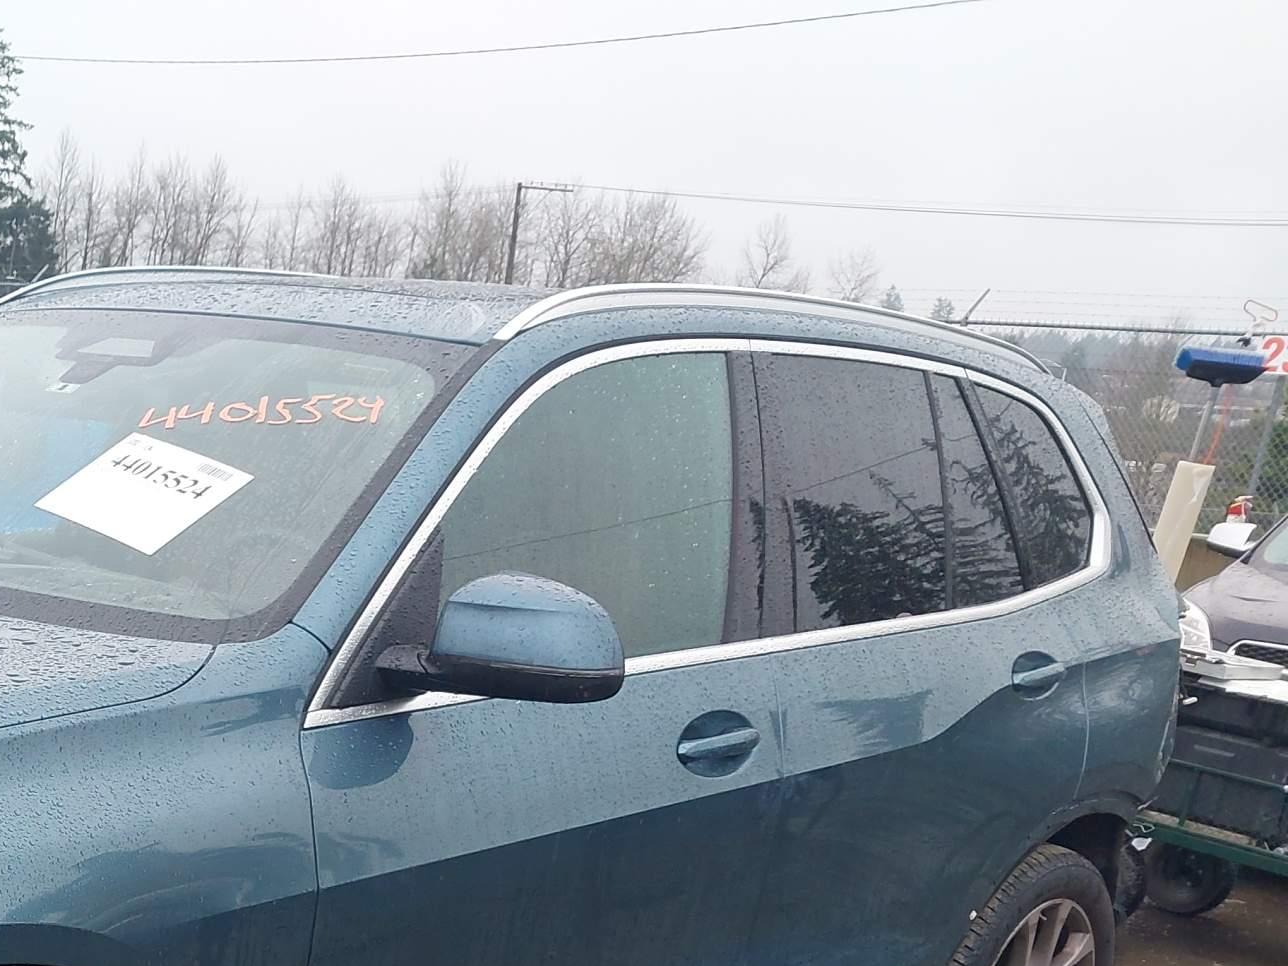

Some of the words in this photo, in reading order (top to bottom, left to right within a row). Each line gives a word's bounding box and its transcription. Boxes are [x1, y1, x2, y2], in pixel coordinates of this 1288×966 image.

[1262, 336, 1288, 372] 2
[138, 393, 385, 429] 44015524
[111, 454, 213, 499] 44015524
